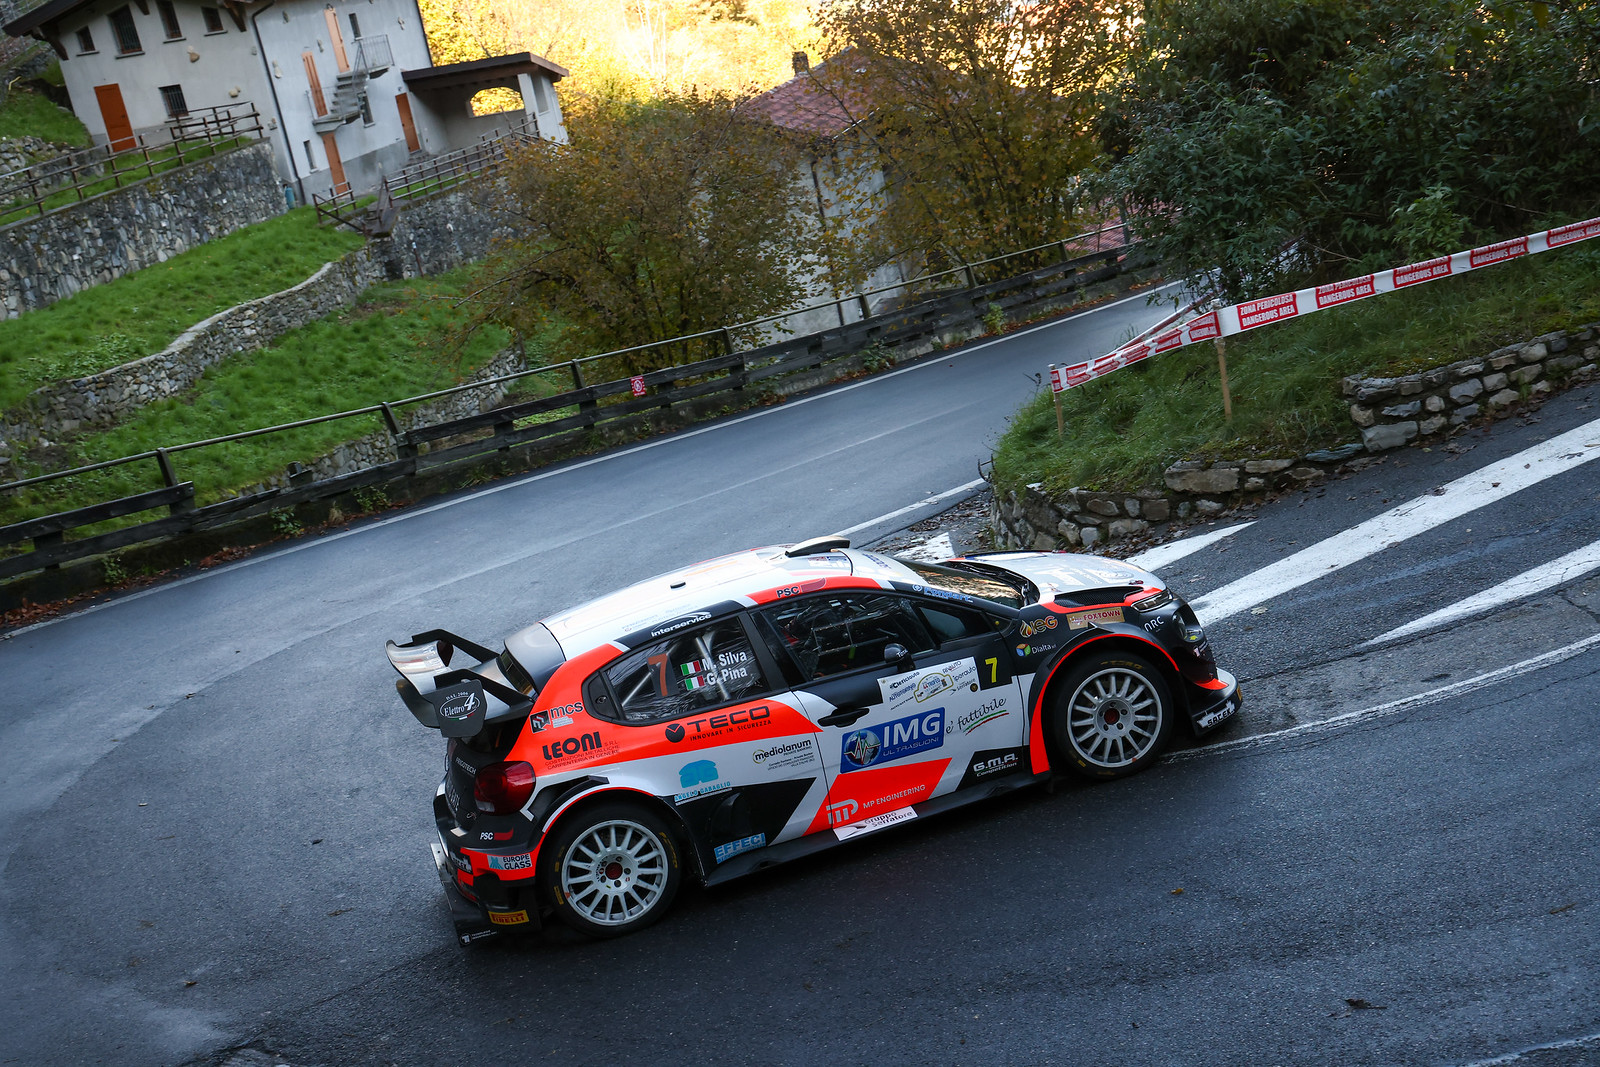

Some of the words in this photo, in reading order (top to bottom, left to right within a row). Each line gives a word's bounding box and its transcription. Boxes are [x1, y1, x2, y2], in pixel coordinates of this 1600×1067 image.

[1473, 249, 1509, 265] DANGEROUS
[1509, 244, 1525, 256] AREA
[1396, 269, 1432, 285] DANGEROUS
[1433, 263, 1449, 276] AREA
[1241, 304, 1256, 315] ZONA
[1257, 294, 1294, 311] PERICOLOSA
[1319, 288, 1355, 305] DANGEROUS
[1356, 283, 1372, 296] AREA
[1242, 309, 1279, 327] DANGEROUS
[1279, 304, 1296, 316] AREA
[776, 586, 800, 598] PSC
[651, 613, 712, 637] interservice
[1083, 610, 1121, 621] FOXTOWN
[1032, 643, 1052, 654] Dialta
[702, 658, 717, 671] M.
[718, 651, 748, 667] Silva
[985, 657, 998, 683] 7
[648, 653, 668, 697] 7
[706, 671, 723, 685] G.
[721, 666, 748, 682] Pina
[550, 702, 584, 719] mcs
[687, 706, 770, 733] TECO
[957, 698, 1007, 730] fattibile
[690, 730, 723, 741] INNOVARE
[737, 720, 772, 731] SICUREZZA
[883, 713, 941, 748] IMG
[542, 731, 602, 760] LEONI
[755, 739, 811, 760] mediolanum
[883, 737, 939, 757] ULTRASUONI
[674, 790, 699, 802] ANGELO
[700, 781, 732, 795] GABAGLIO
[863, 800, 876, 809] MP
[876, 784, 926, 805] ENGINEERING
[864, 812, 897, 825] Gruppo
[872, 811, 913, 828] Serratore
[480, 832, 494, 840] PSC
[715, 833, 765, 858] EFFECI
[503, 853, 530, 863] EUROPE
[504, 861, 531, 870] GLASS
